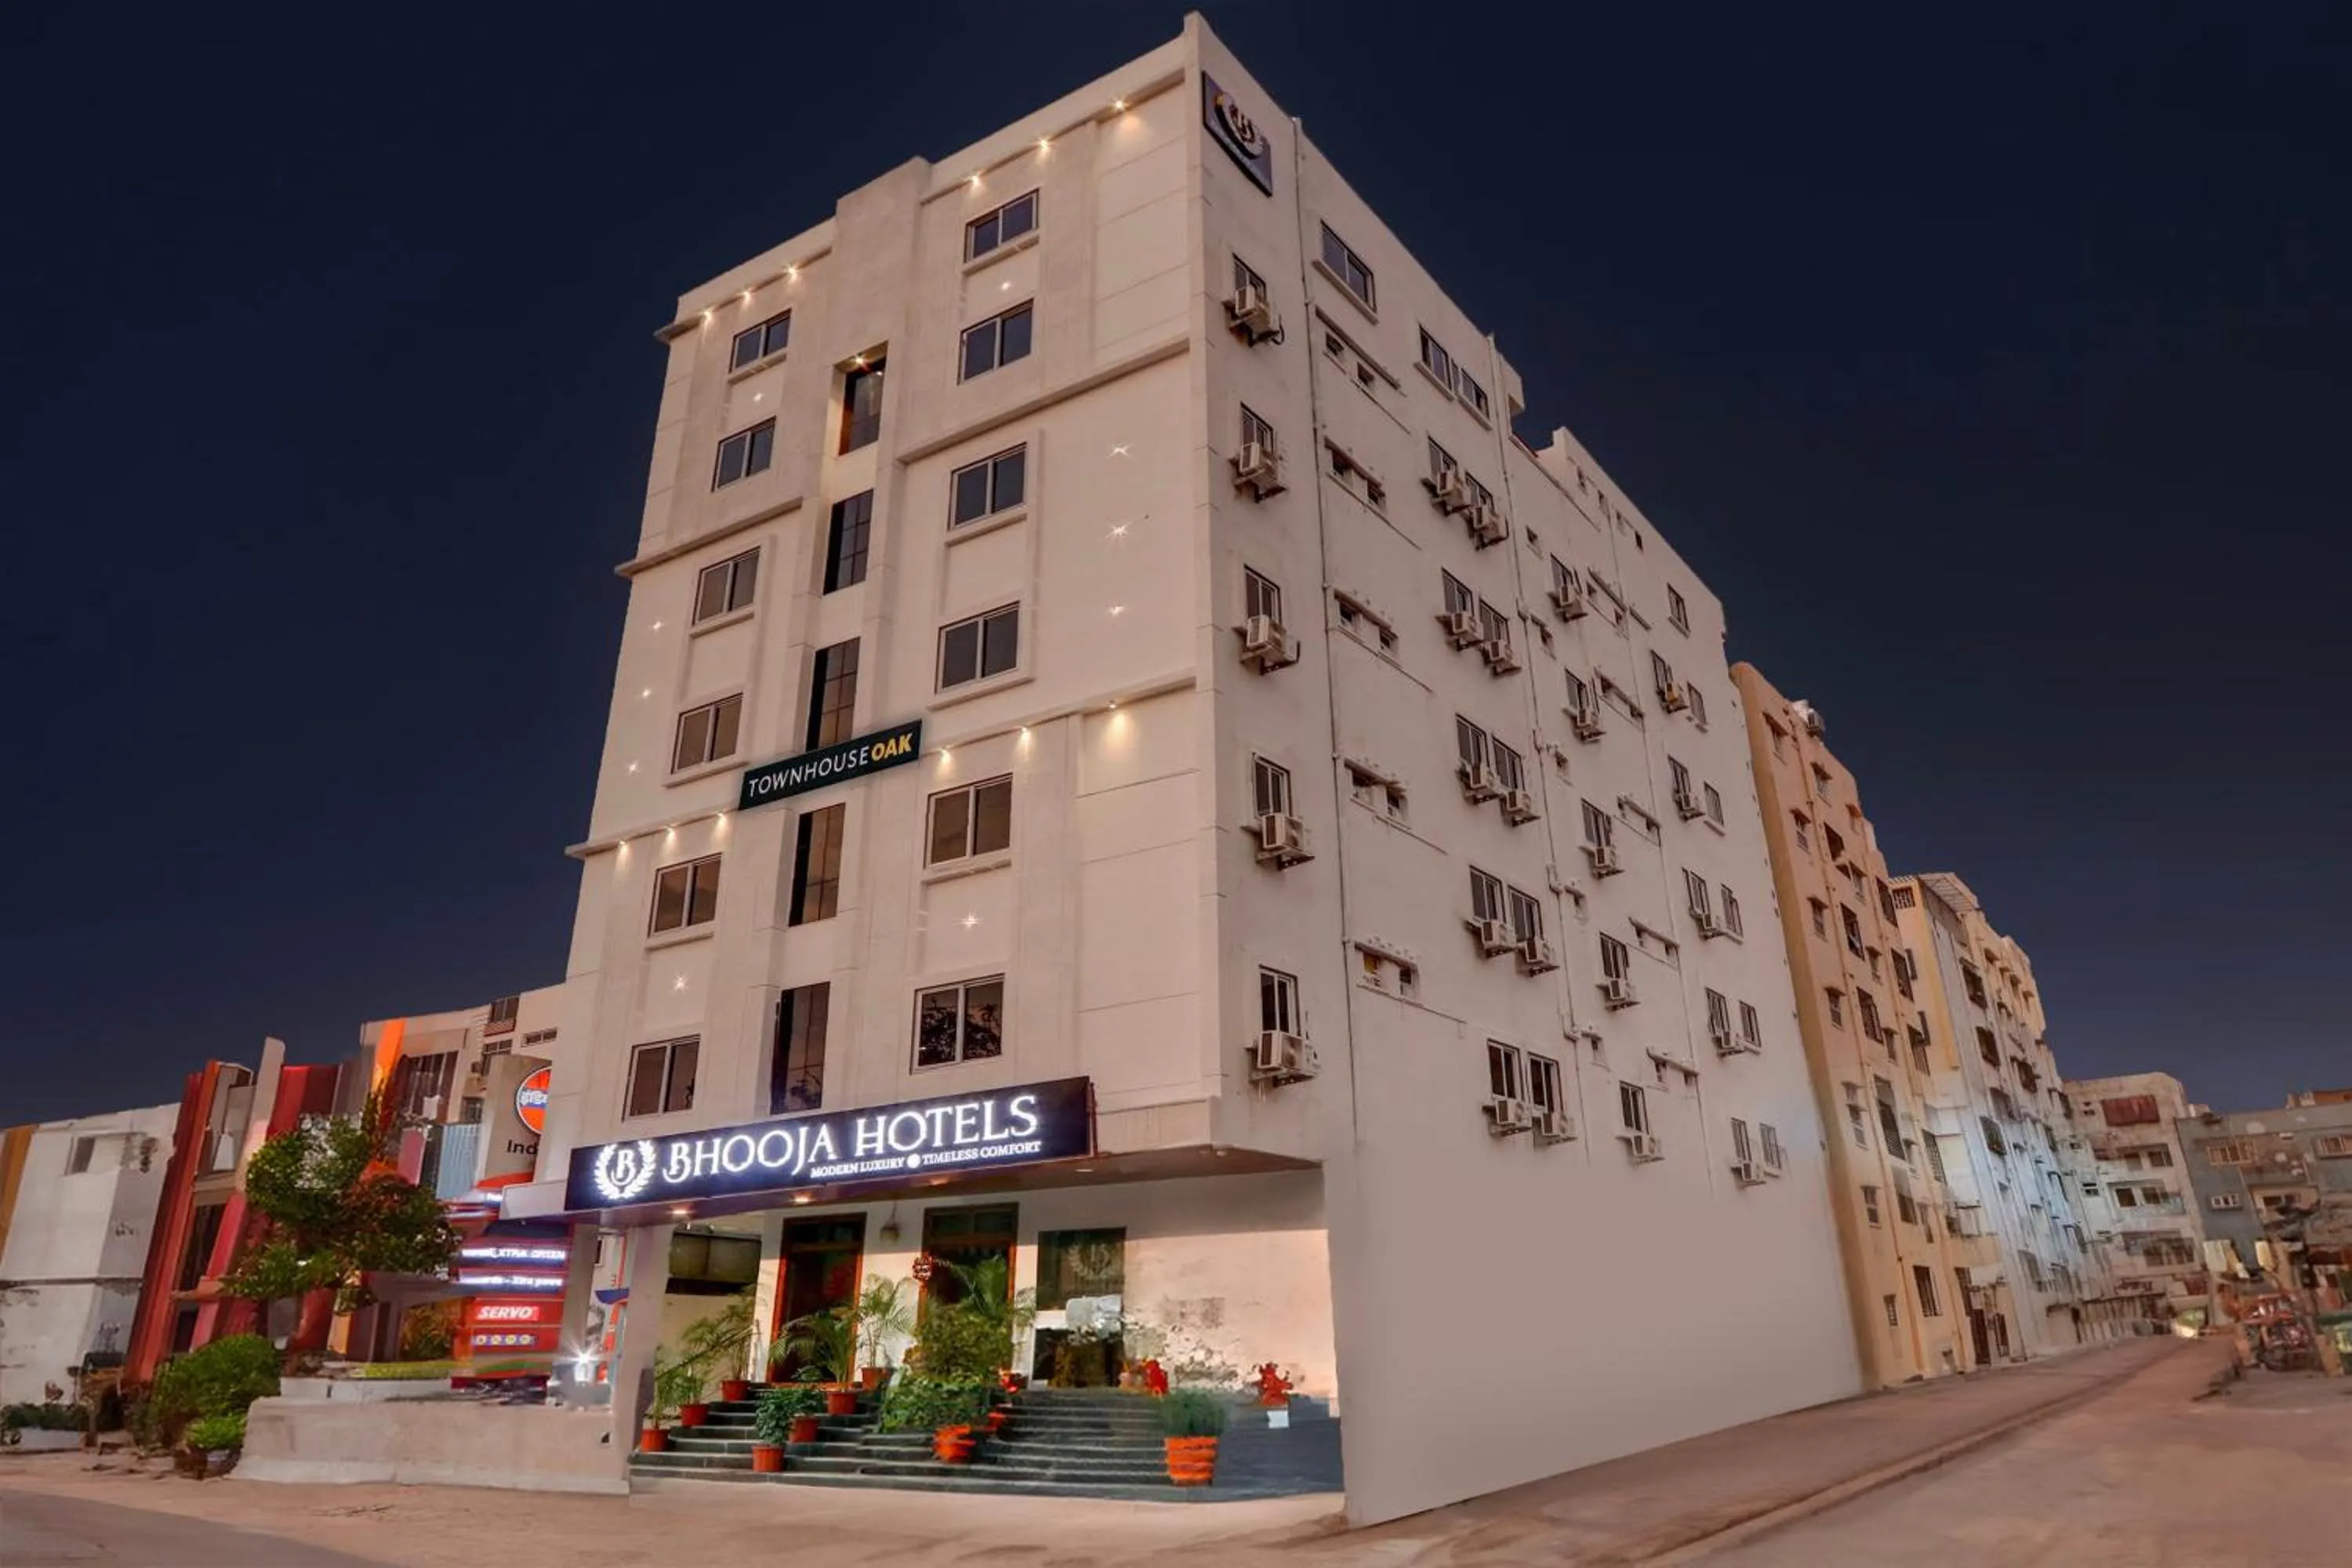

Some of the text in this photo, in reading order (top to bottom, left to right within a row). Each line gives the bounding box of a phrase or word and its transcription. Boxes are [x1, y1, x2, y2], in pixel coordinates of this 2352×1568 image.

[749, 732, 913, 797] TOWNHOUSE OAK
[662, 1094, 1039, 1183] BHOOJA HOTELS
[811, 1141, 1042, 1178] MODERN LUXURY TIMELESS COMFORT
[477, 1305, 534, 1319] SERVO
